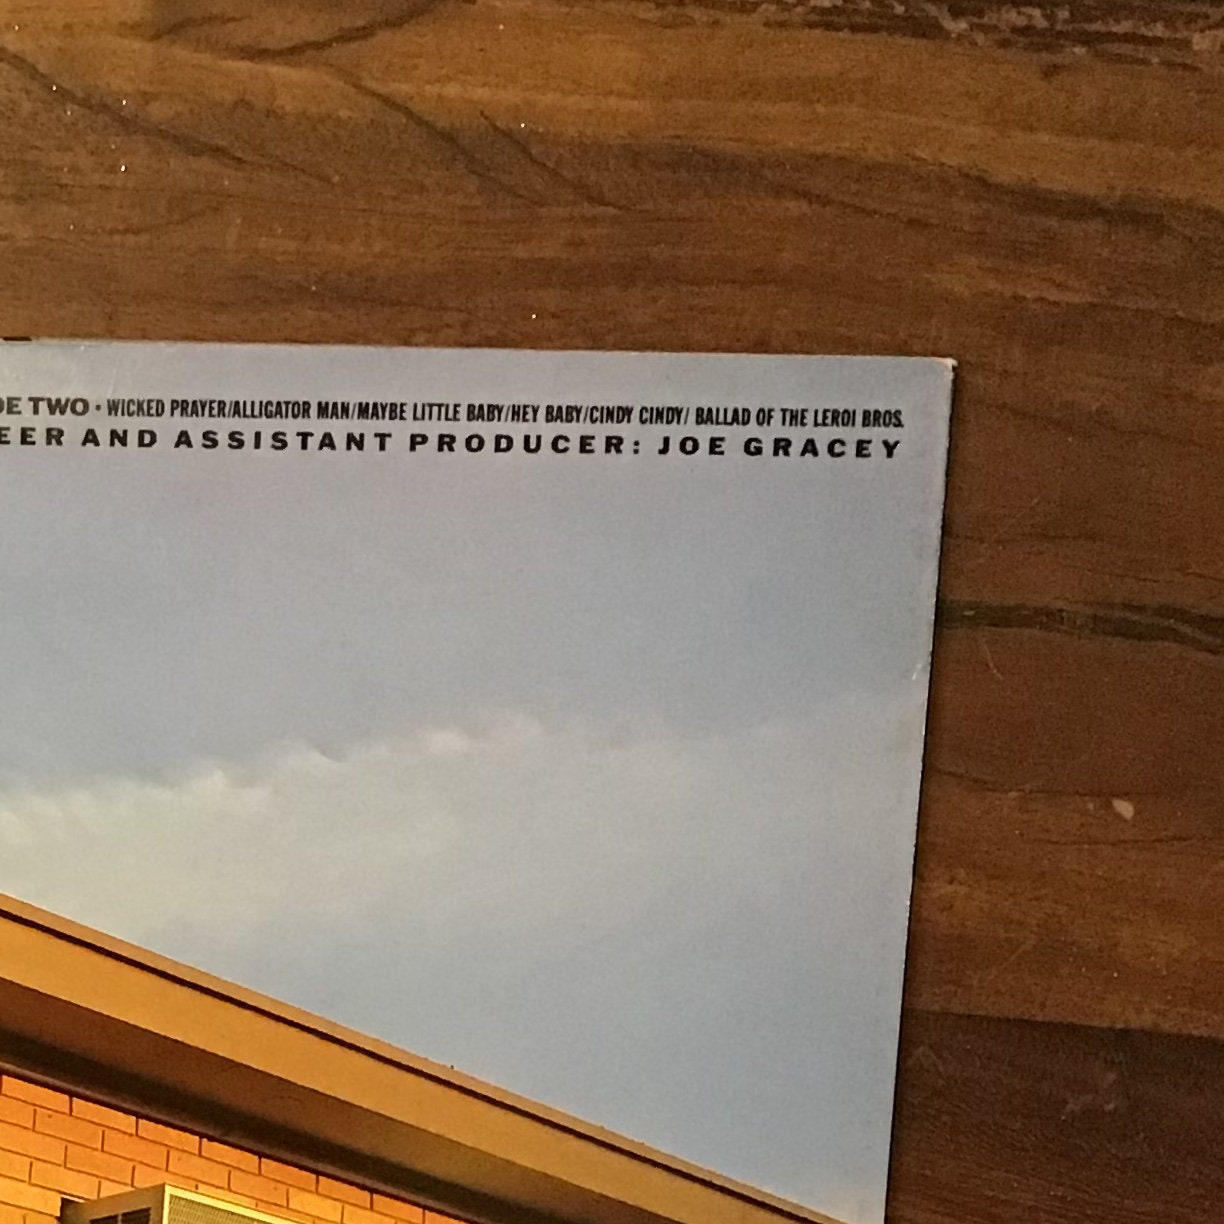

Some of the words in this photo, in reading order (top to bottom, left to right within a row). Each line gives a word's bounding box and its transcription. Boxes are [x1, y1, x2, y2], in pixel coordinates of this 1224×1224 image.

[28, 396, 90, 416] TWO
[107, 398, 165, 417] WICKED
[412, 403, 461, 422] LITTLE
[695, 406, 751, 426] BALLAD
[755, 407, 775, 427] OF
[780, 408, 808, 427] THE
[813, 408, 856, 428] LEROI
[861, 409, 904, 429] BROS.
[80, 428, 157, 448] AND
[174, 429, 392, 451] ASSISTANT
[409, 433, 640, 455] PRODUCER:
[658, 436, 726, 456] JOE
[743, 437, 901, 458] GRACEY
